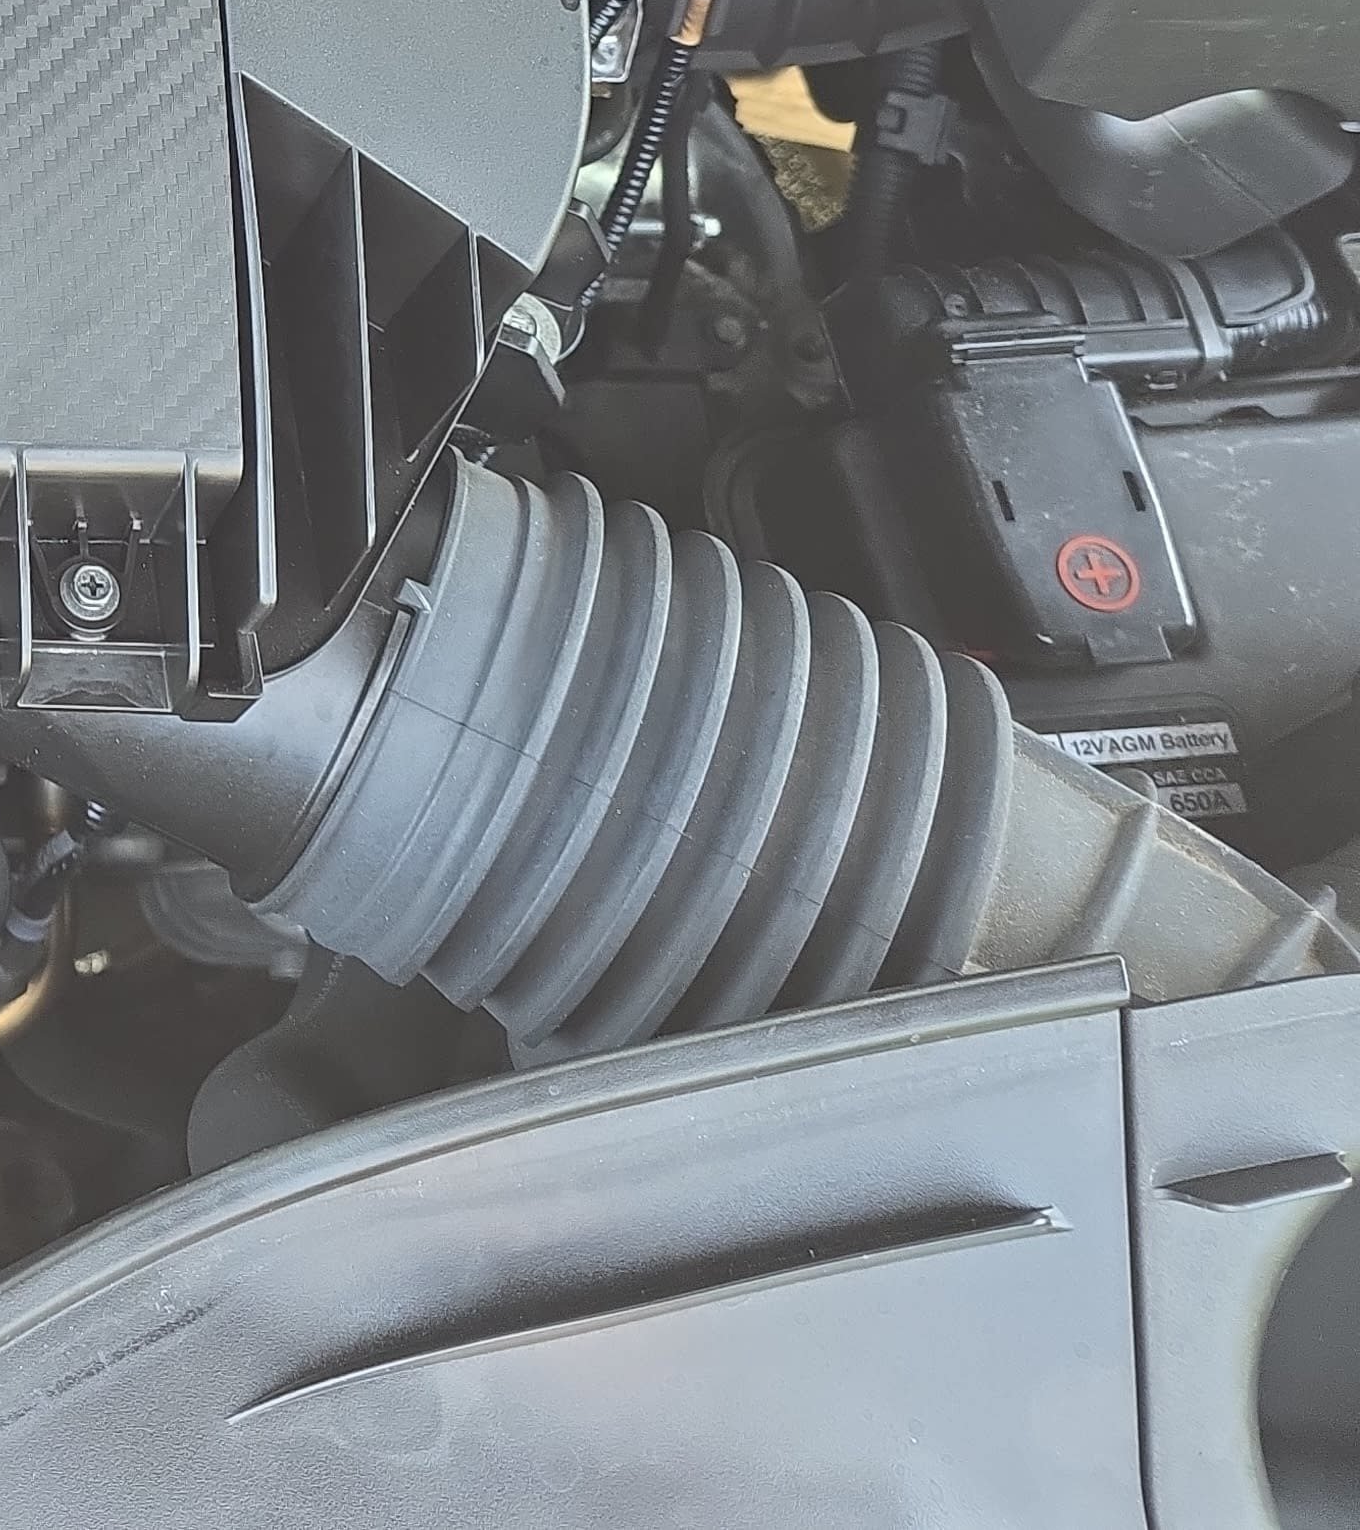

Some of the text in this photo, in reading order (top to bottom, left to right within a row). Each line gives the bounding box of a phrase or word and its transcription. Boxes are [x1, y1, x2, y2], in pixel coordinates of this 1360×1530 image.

[1071, 738, 1107, 757] 12V
[1107, 734, 1157, 753] AGM
[1161, 730, 1230, 751] Battery
[1154, 769, 1227, 785] SAE CCA
[1171, 791, 1232, 813] 650A
